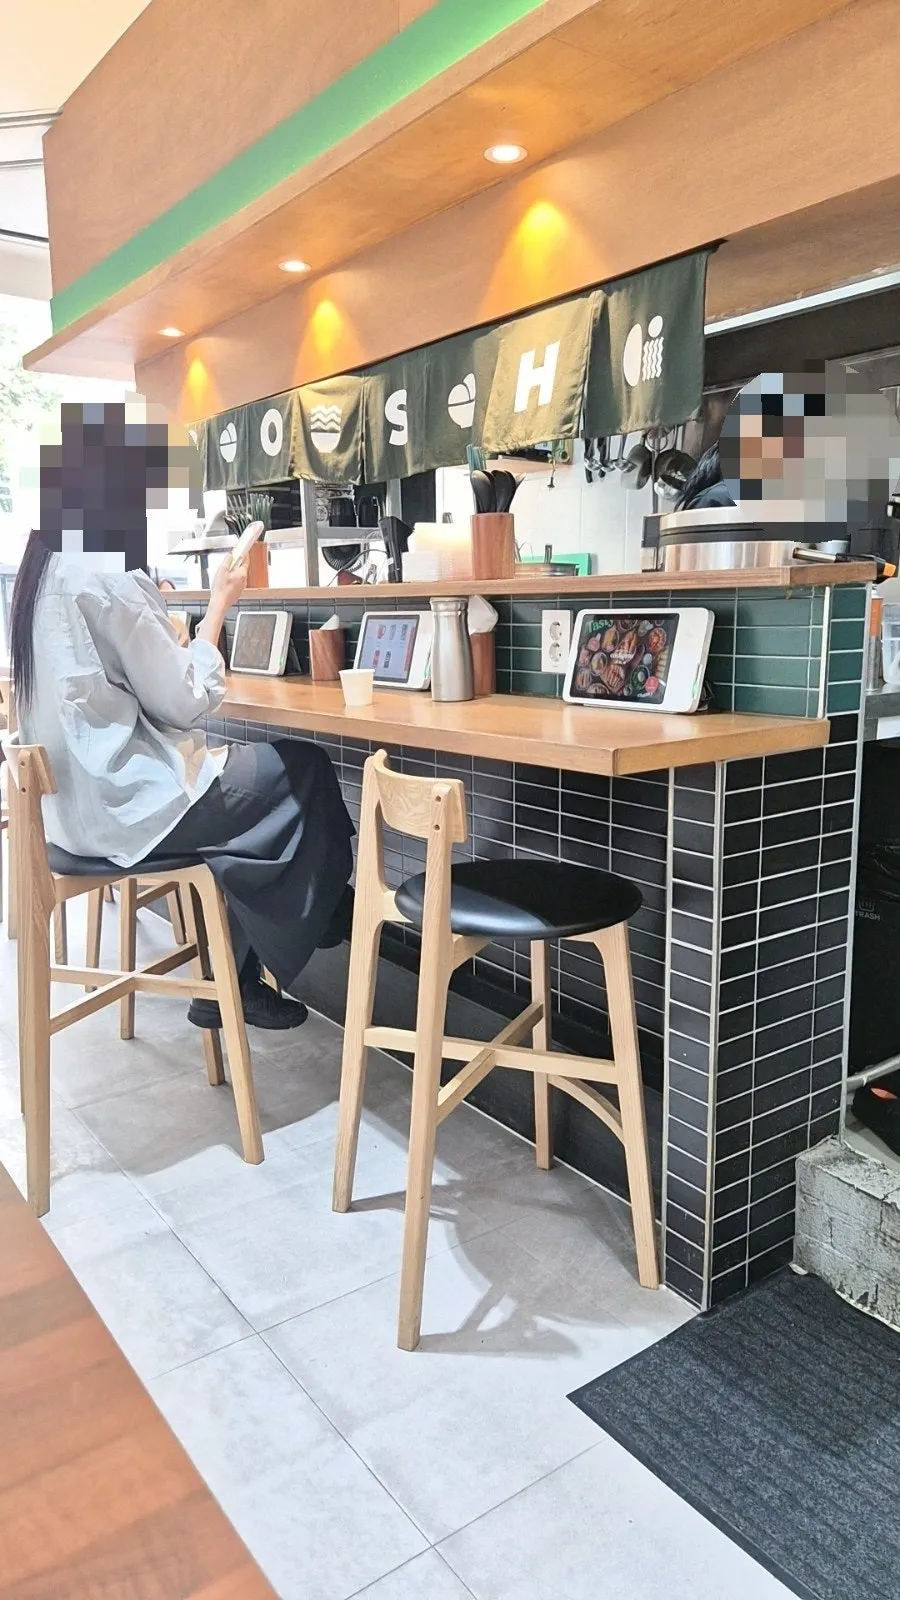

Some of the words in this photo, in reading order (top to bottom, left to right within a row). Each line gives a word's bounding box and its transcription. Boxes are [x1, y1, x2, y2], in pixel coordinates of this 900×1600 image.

[260, 408, 283, 456] O
[385, 388, 408, 446] S
[513, 341, 560, 413] H
[586, 618, 614, 633] Tasty
